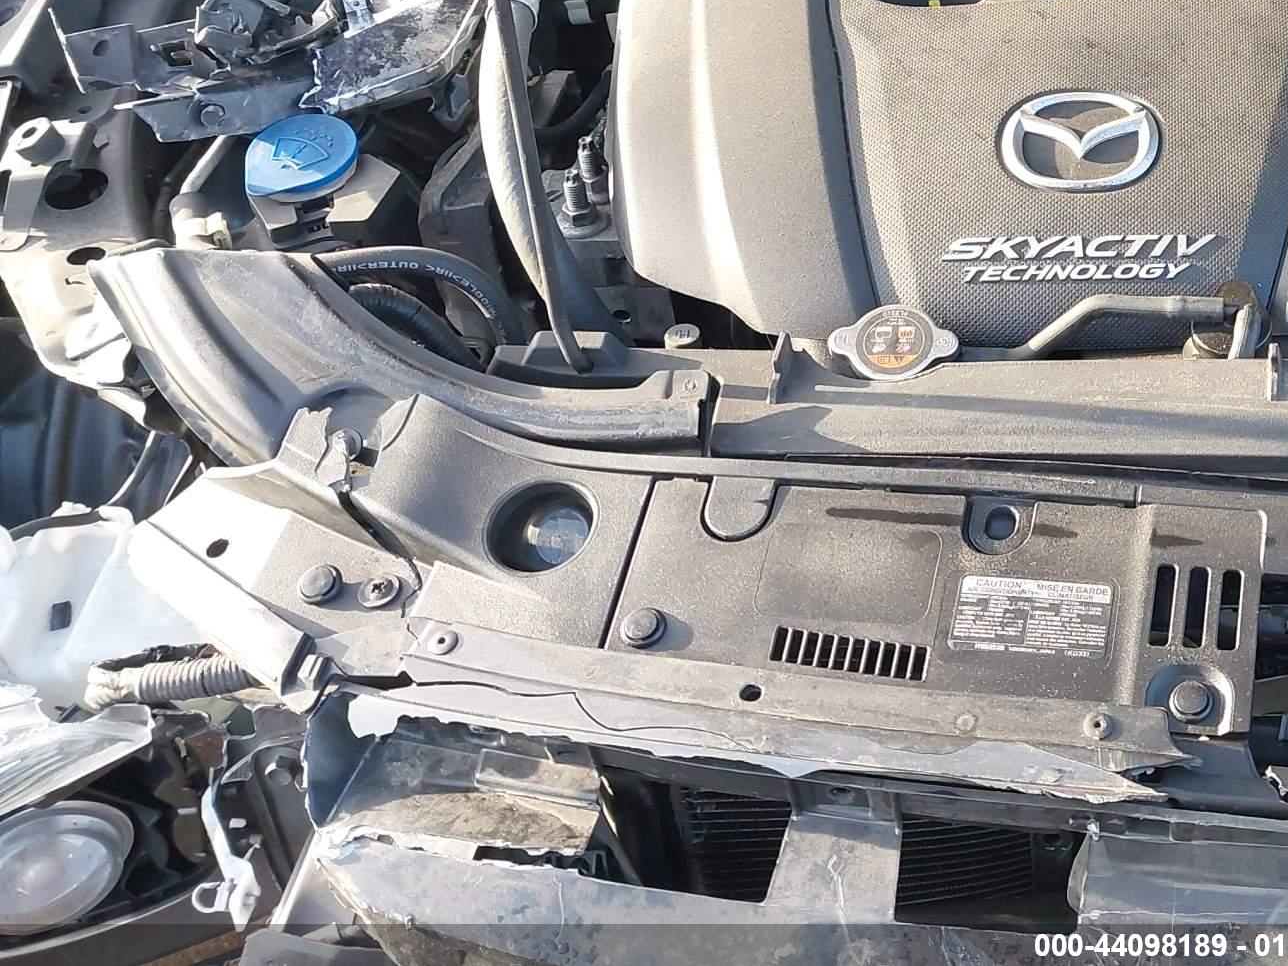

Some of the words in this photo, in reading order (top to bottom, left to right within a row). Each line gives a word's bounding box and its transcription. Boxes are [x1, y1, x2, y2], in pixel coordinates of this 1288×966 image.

[941, 234, 1217, 261] SKYACTIV
[963, 262, 1192, 284] TECHNOLOGY
[976, 578, 1023, 590] CAUTION
[1036, 583, 1061, 593] MISE
[1060, 585, 1074, 594] EN
[1075, 586, 1110, 596] GARDE
